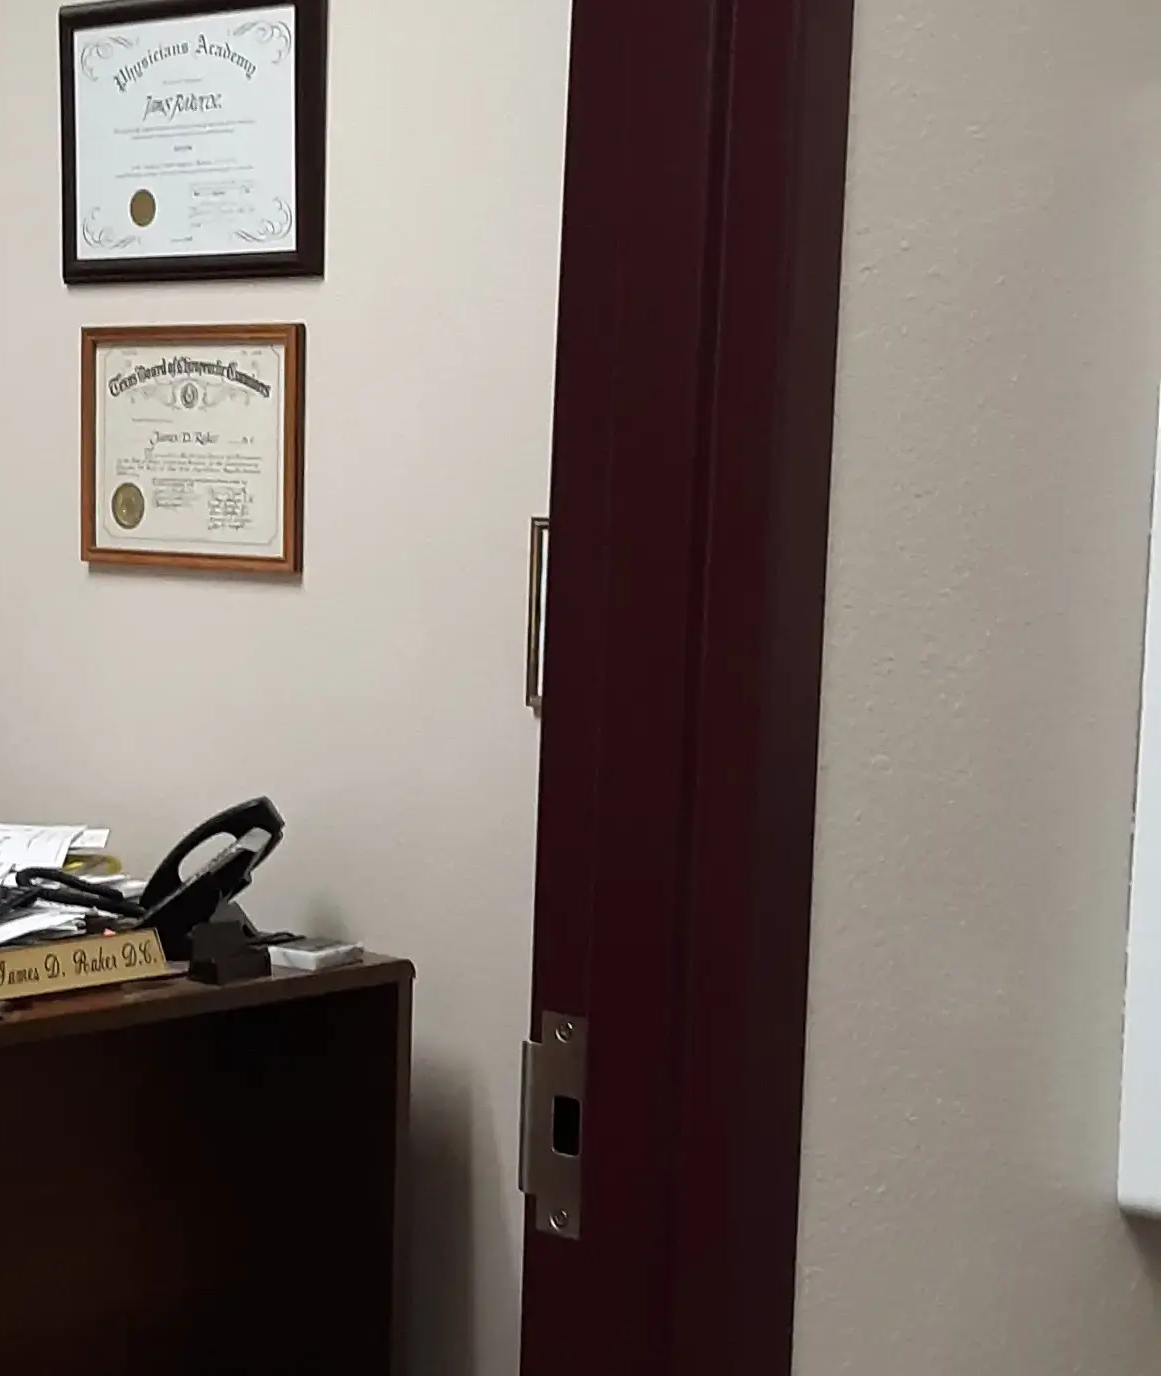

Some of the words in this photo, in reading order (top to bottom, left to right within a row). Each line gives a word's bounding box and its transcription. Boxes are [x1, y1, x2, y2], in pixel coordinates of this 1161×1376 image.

[113, 42, 189, 92] Physicians
[195, 33, 256, 80] Academy
[45, 953, 66, 979] D.
[73, 947, 117, 974] Raker
[122, 939, 157, 968] D.C.
